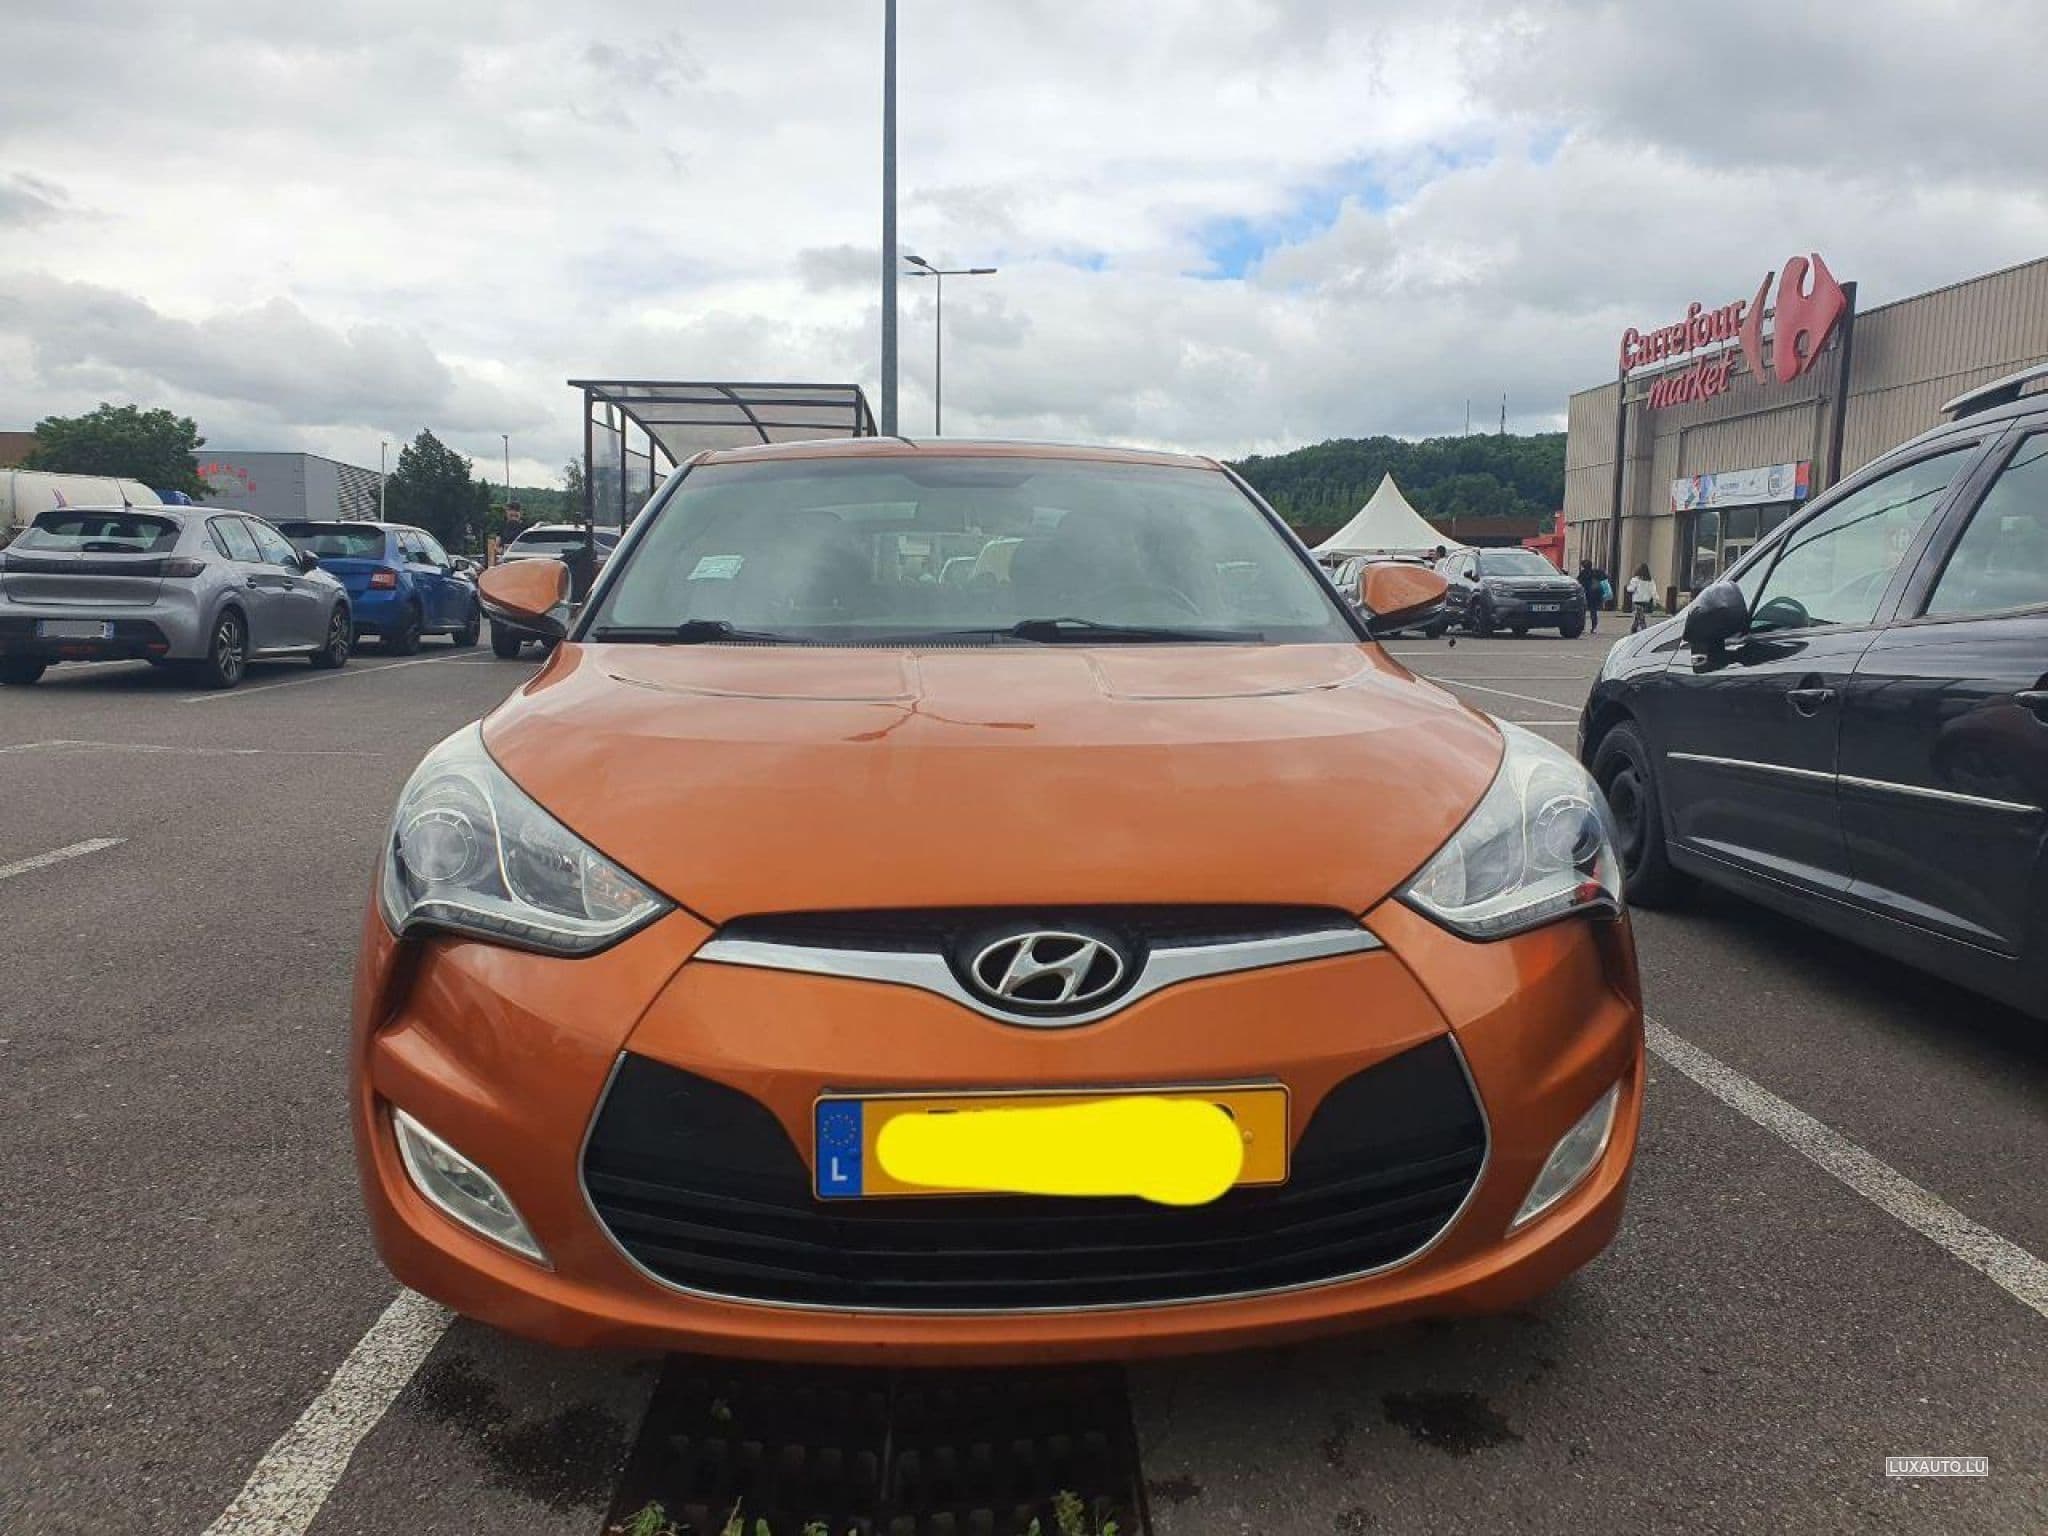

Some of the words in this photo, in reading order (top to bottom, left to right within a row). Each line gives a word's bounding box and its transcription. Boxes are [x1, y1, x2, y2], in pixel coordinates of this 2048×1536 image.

[1620, 300, 1746, 371] Carrefour
[1647, 349, 1735, 410] market
[831, 1156, 848, 1181] L
